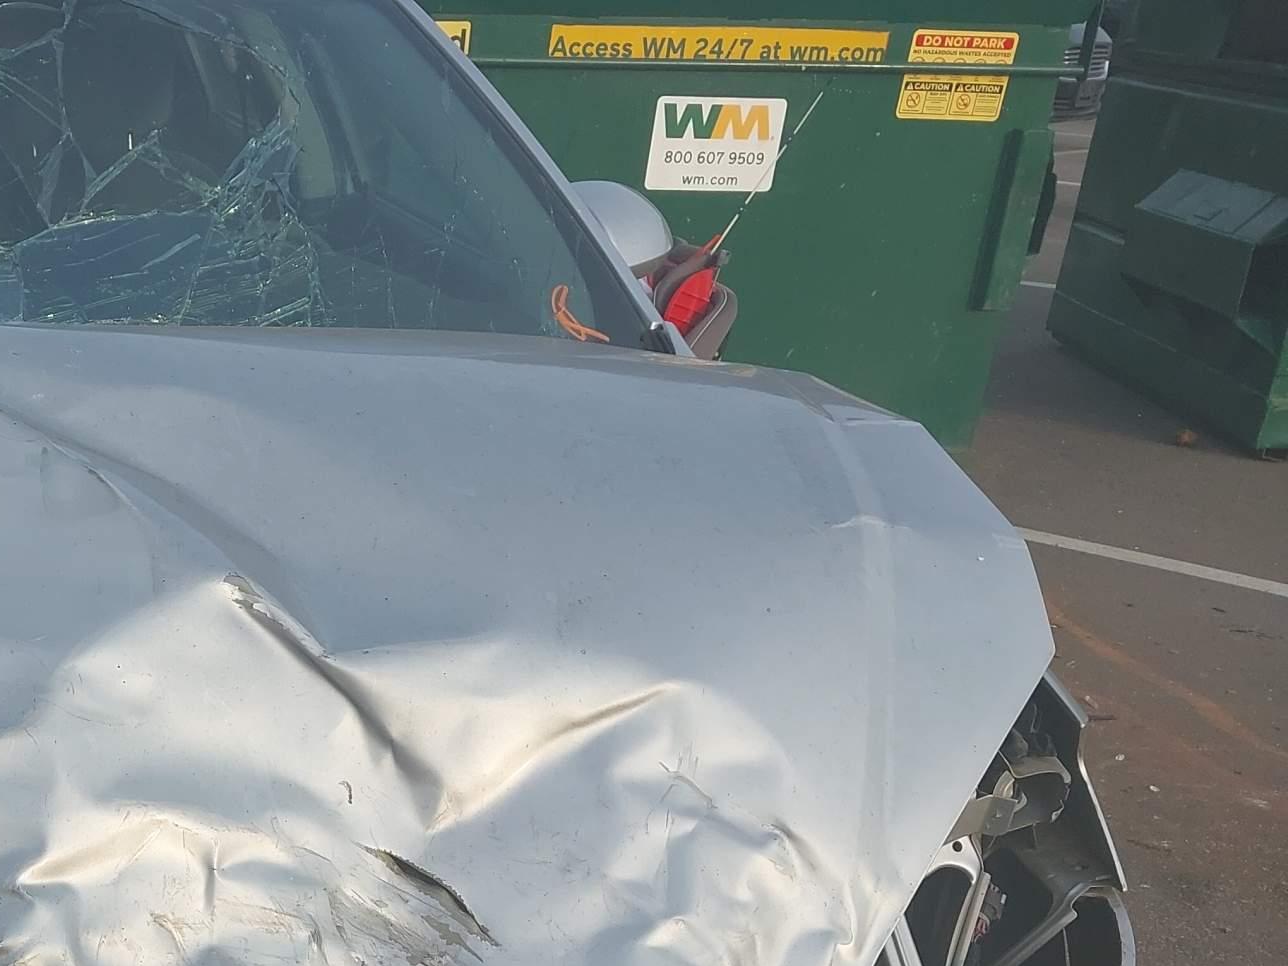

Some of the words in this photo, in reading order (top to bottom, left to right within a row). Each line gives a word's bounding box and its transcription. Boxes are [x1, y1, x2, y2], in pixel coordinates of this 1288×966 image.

[551, 36, 633, 58] Access
[642, 37, 686, 59] WM
[693, 38, 754, 60] 24/7
[759, 41, 782, 61] at
[789, 45, 886, 62] wm.com
[922, 35, 942, 46] DO
[944, 36, 971, 47] NOT
[972, 38, 1007, 49] PARK
[914, 83, 950, 91] CAUTION
[964, 85, 1001, 93] CAUTION
[664, 103, 770, 140] WM
[664, 151, 693, 164] 800
[697, 151, 725, 164] 607
[728, 152, 765, 165] 9509
[682, 175, 738, 186] wm.com
